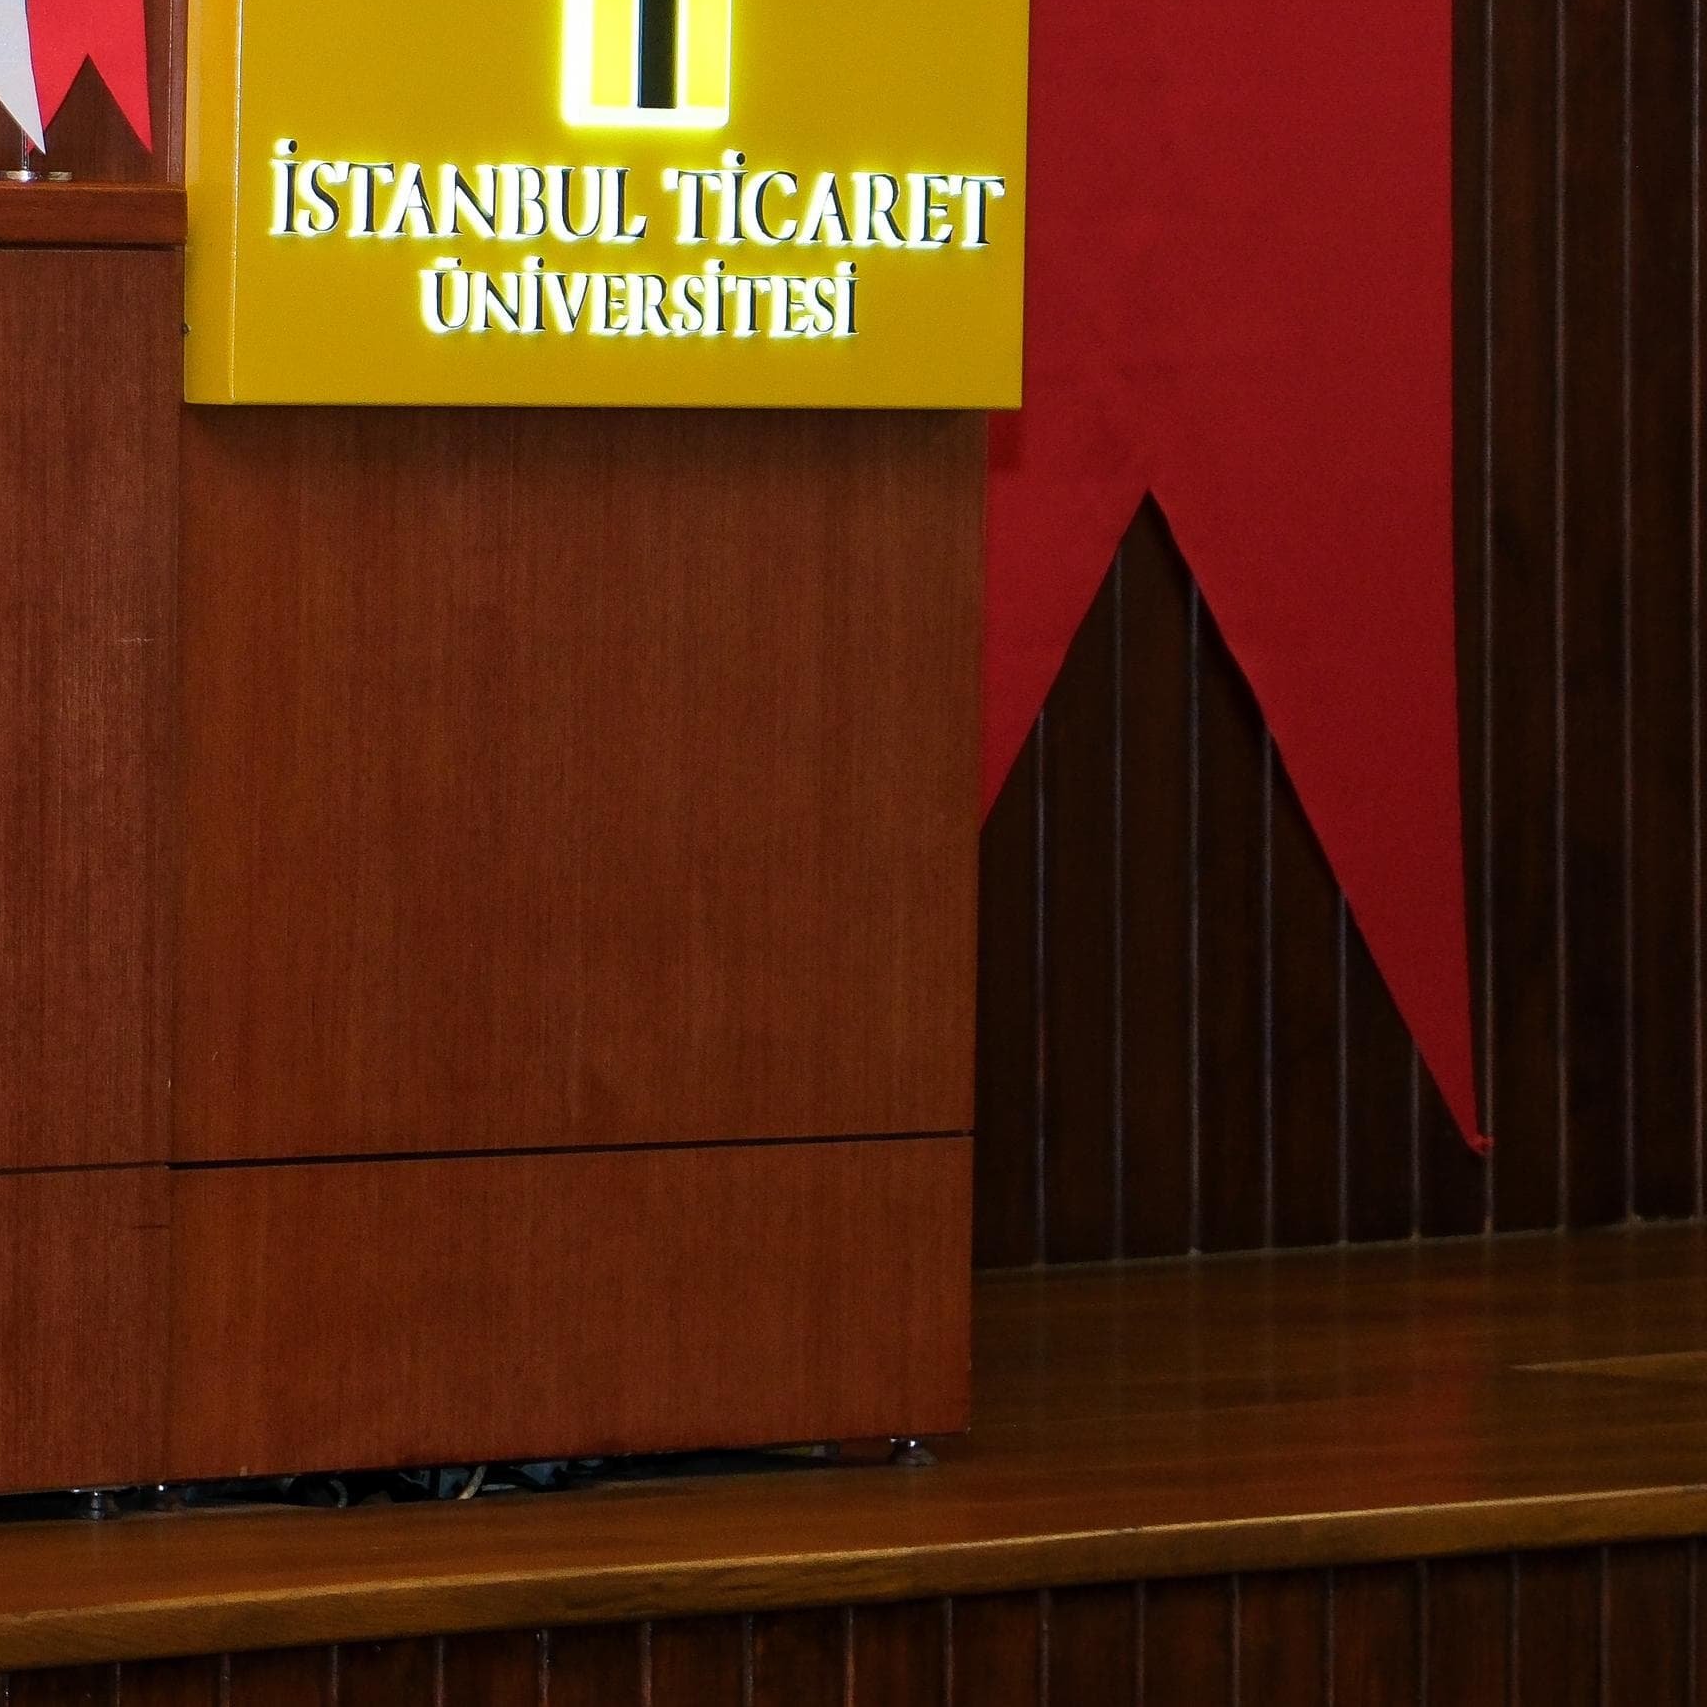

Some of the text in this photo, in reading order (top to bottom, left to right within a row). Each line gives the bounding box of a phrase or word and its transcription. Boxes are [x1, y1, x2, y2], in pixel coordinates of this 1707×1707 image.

[270, 138, 1005, 248] İSTANBUL TİCARET
[420, 256, 860, 337] ÜNİVERSİTESİ
